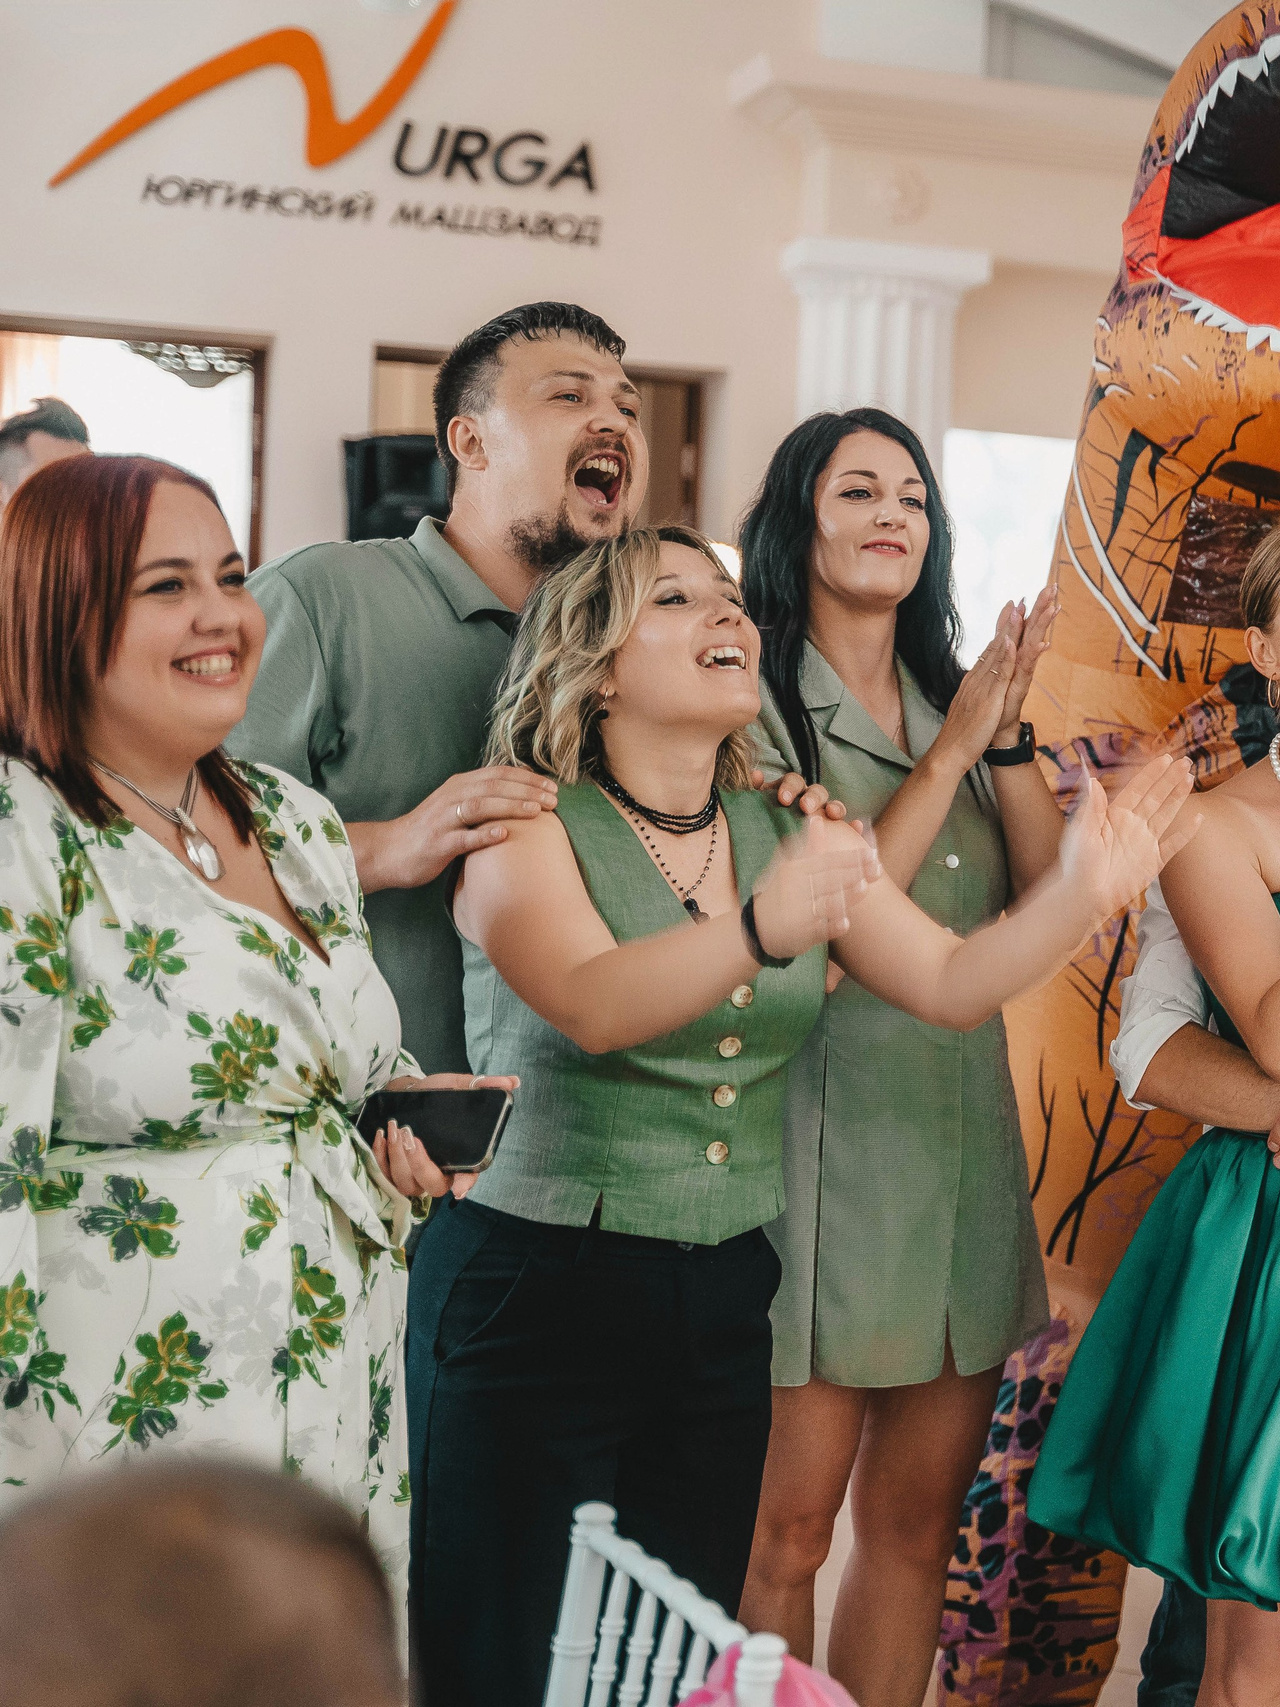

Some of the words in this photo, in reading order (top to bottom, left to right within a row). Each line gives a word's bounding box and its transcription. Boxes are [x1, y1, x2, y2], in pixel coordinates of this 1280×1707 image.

[393, 119, 597, 193] URGA
[141, 174, 376, 222] ЮРГИНСКИЙ
[391, 202, 602, 247] МАШЗАВОД
